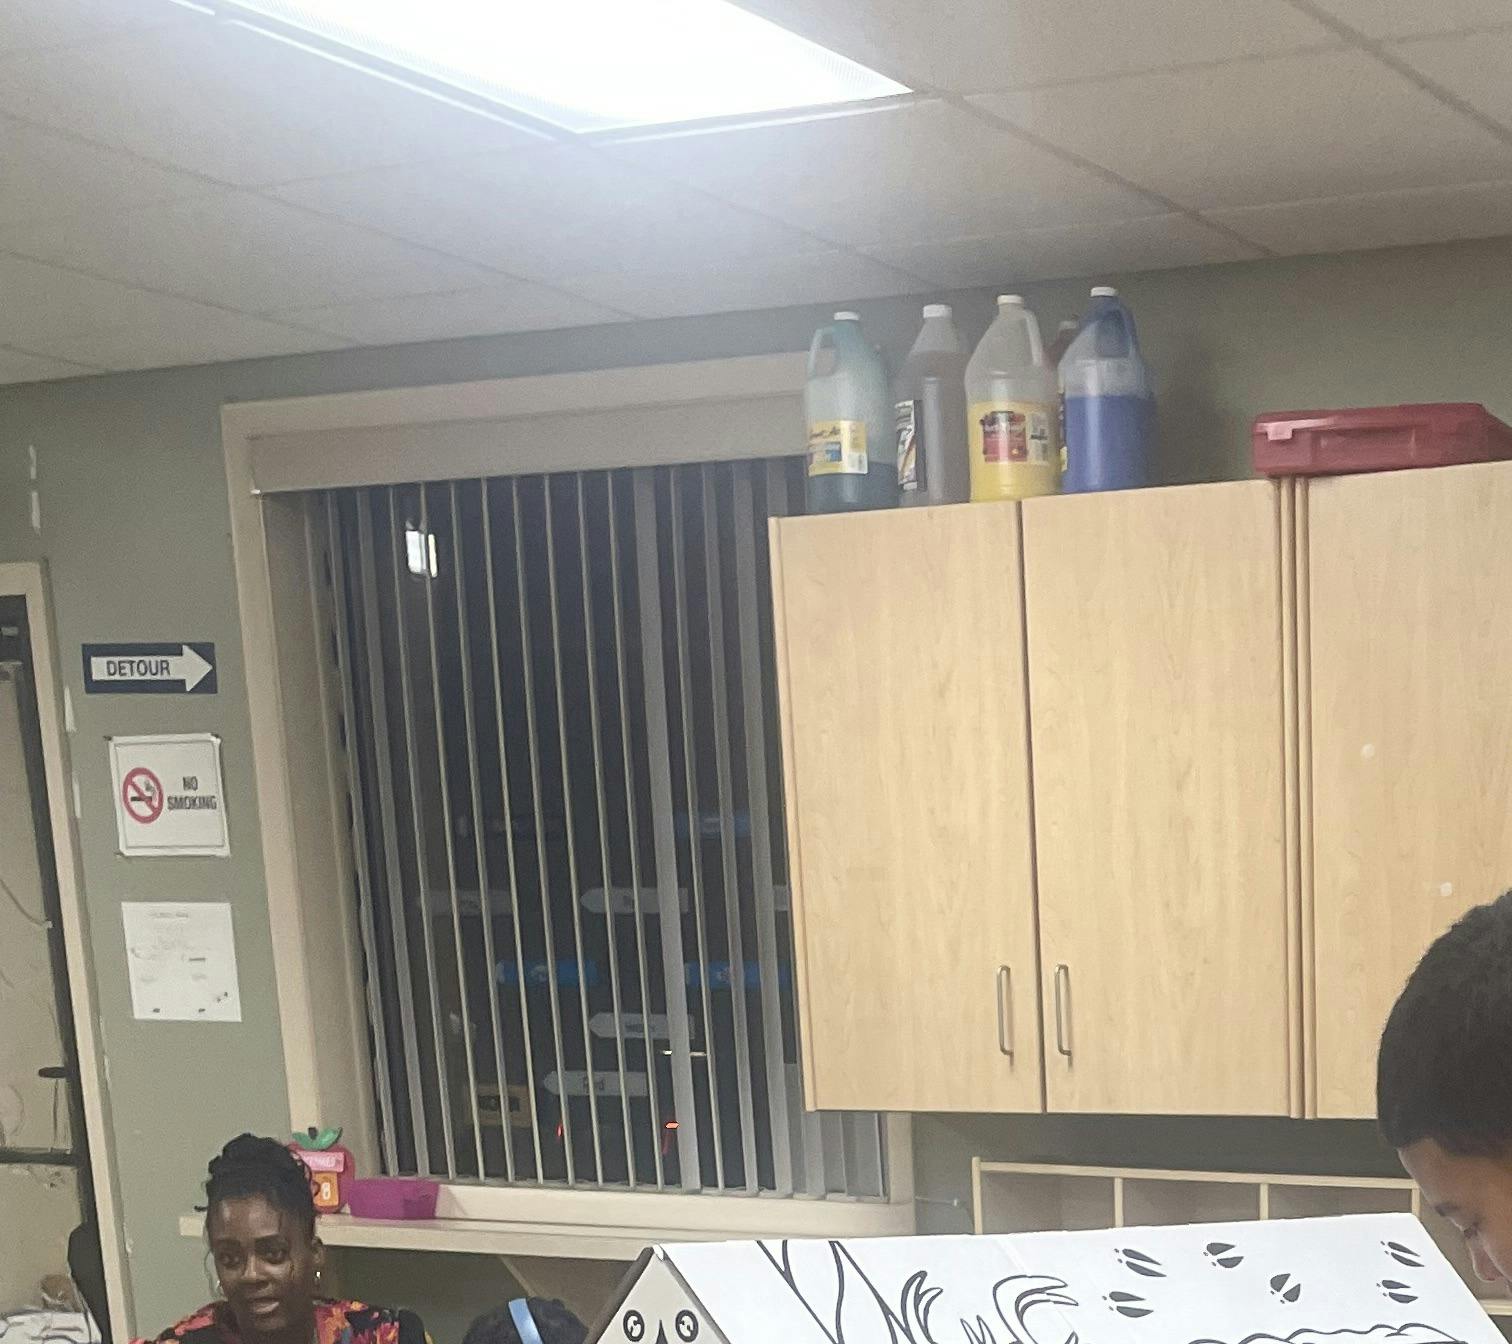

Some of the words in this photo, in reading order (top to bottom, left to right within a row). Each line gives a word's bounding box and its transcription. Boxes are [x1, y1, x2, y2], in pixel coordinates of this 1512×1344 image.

[106, 659, 171, 677] DETOUR
[182, 776, 198, 791] NO
[167, 795, 217, 811] SMOKING
